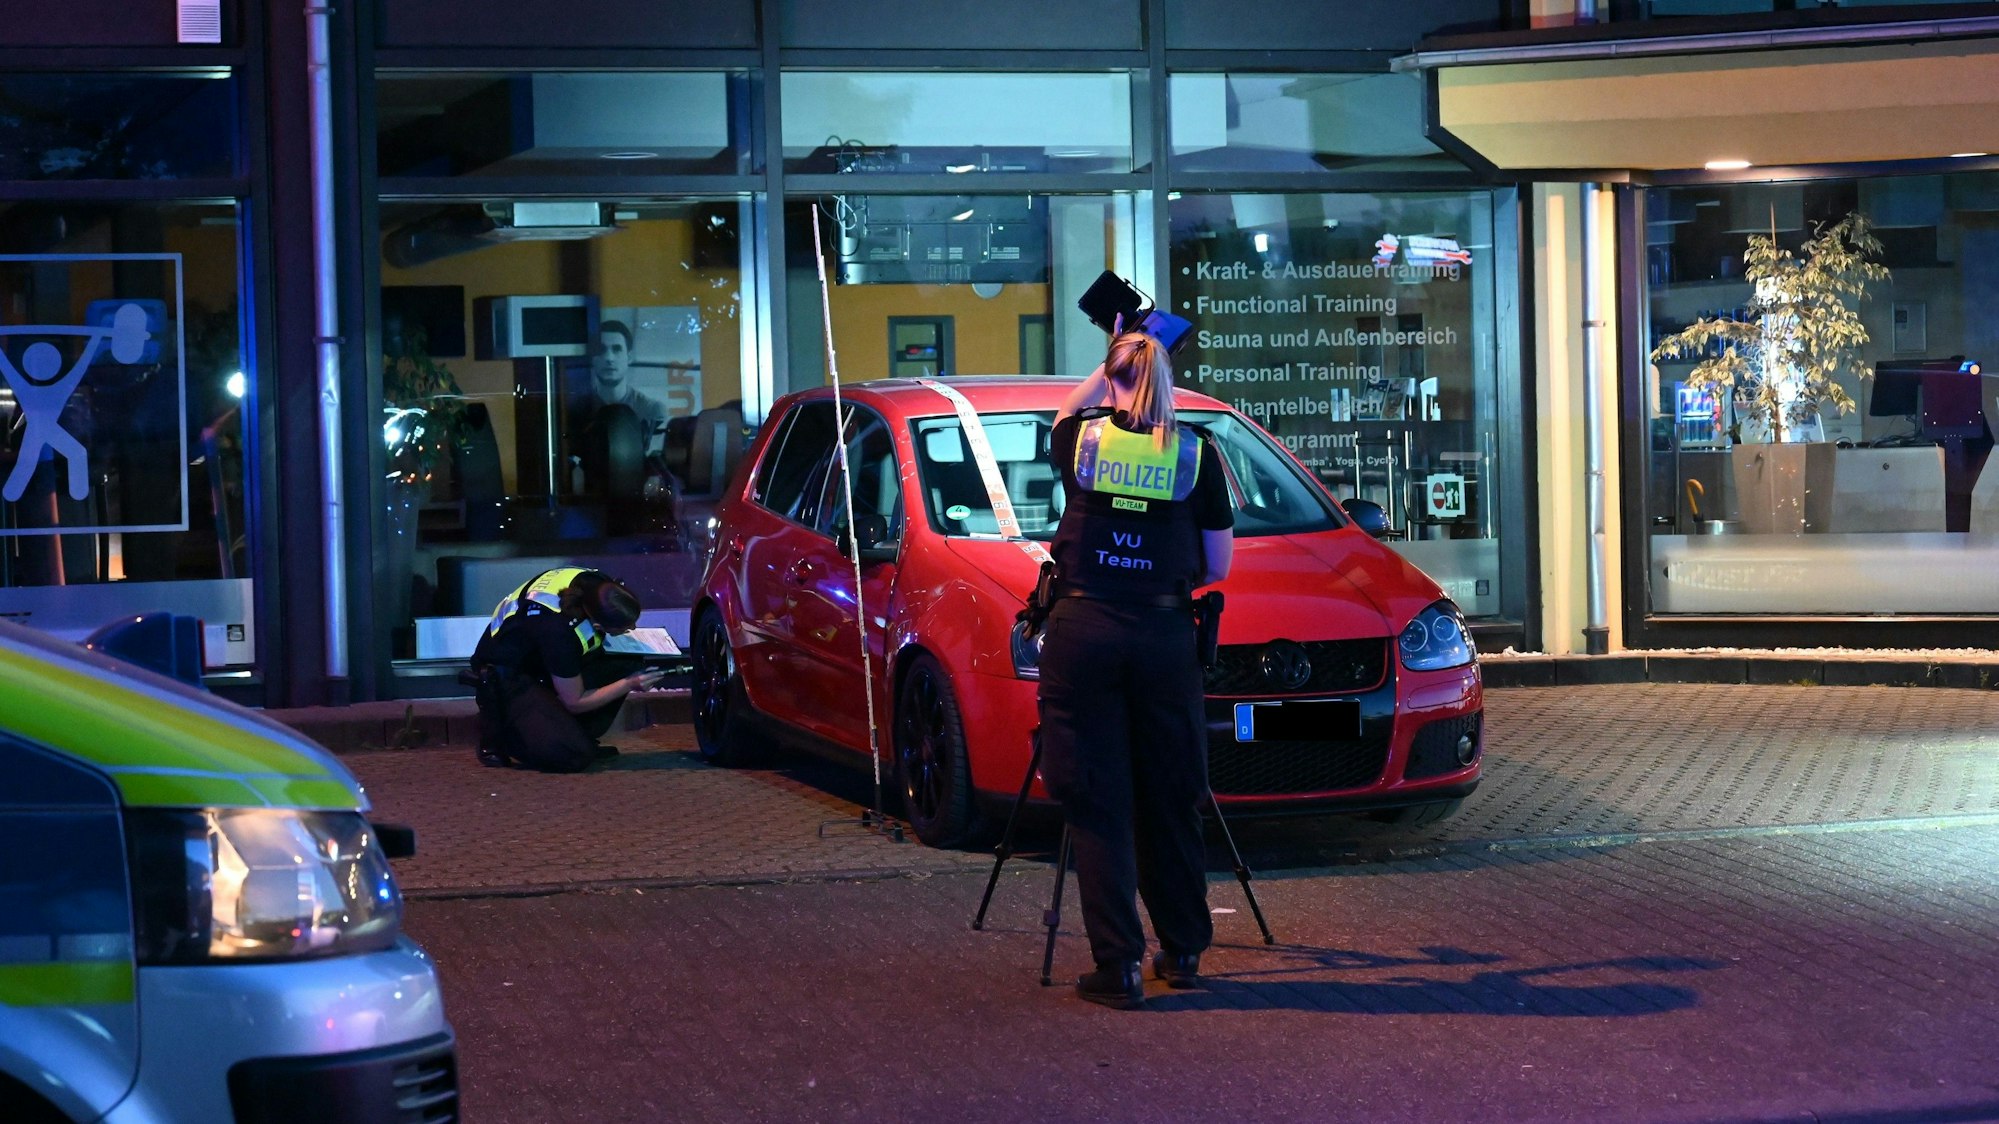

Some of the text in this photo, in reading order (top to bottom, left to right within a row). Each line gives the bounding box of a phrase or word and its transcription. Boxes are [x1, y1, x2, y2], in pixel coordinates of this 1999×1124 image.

[1197, 258, 1460, 282] Kraft- & Ausdauertraining
[1197, 294, 1397, 316] Functional Training
[1198, 326, 1457, 349] Sauna und Außenbereich
[1199, 362, 1381, 384] Personal Training
[1227, 396, 1381, 417] ihantelbeeich
[1097, 460, 1173, 491] POLIZEI
[1115, 499, 1144, 510] VU-TEAM
[1113, 532, 1141, 548] VU
[1096, 550, 1152, 570] Team
